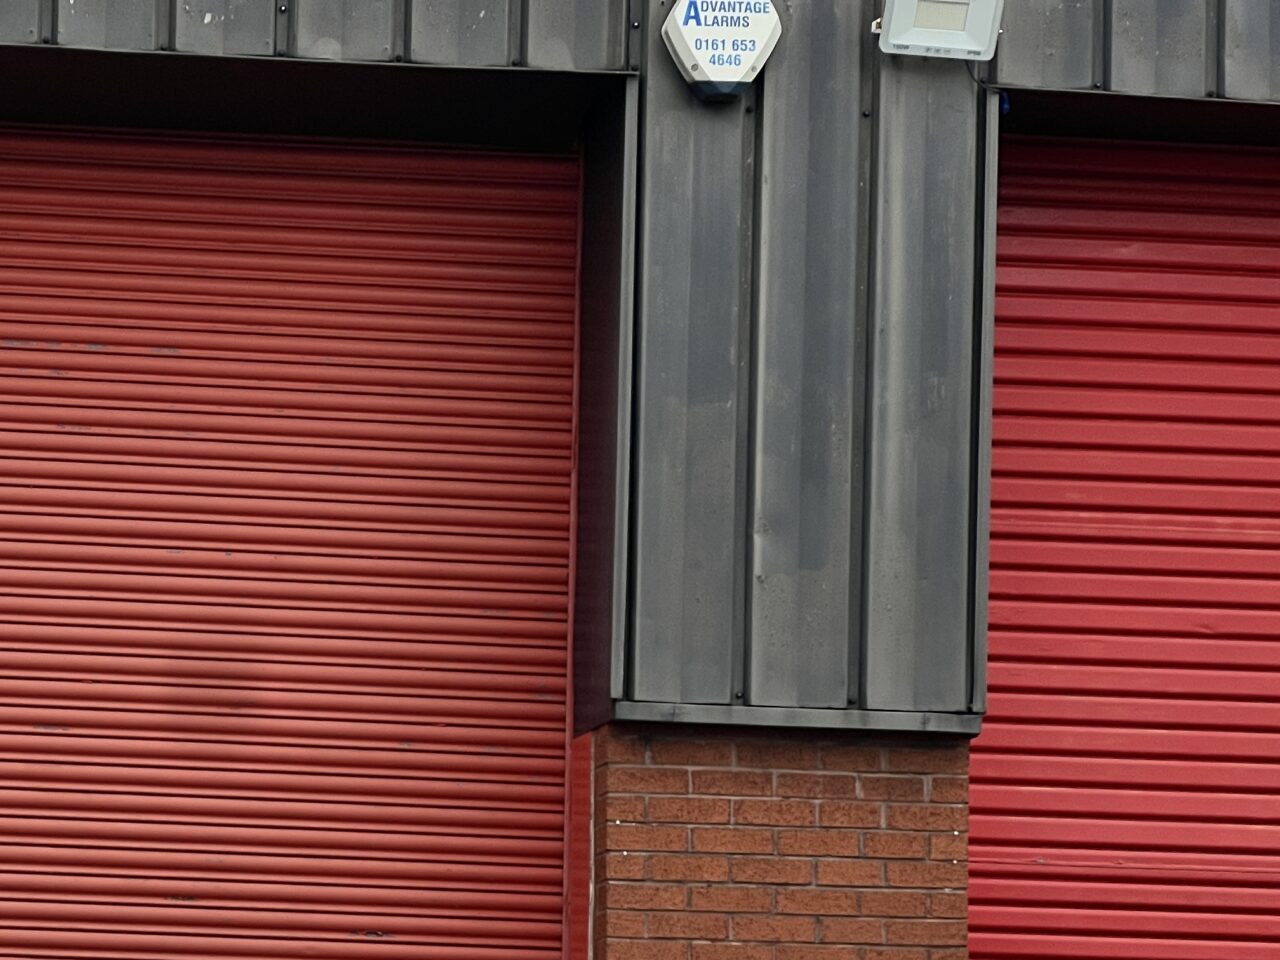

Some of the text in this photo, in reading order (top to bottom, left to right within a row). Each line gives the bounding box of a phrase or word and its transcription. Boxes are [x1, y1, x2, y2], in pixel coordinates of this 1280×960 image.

[694, 38, 757, 52] 0161 653
[708, 54, 742, 66] 4646
